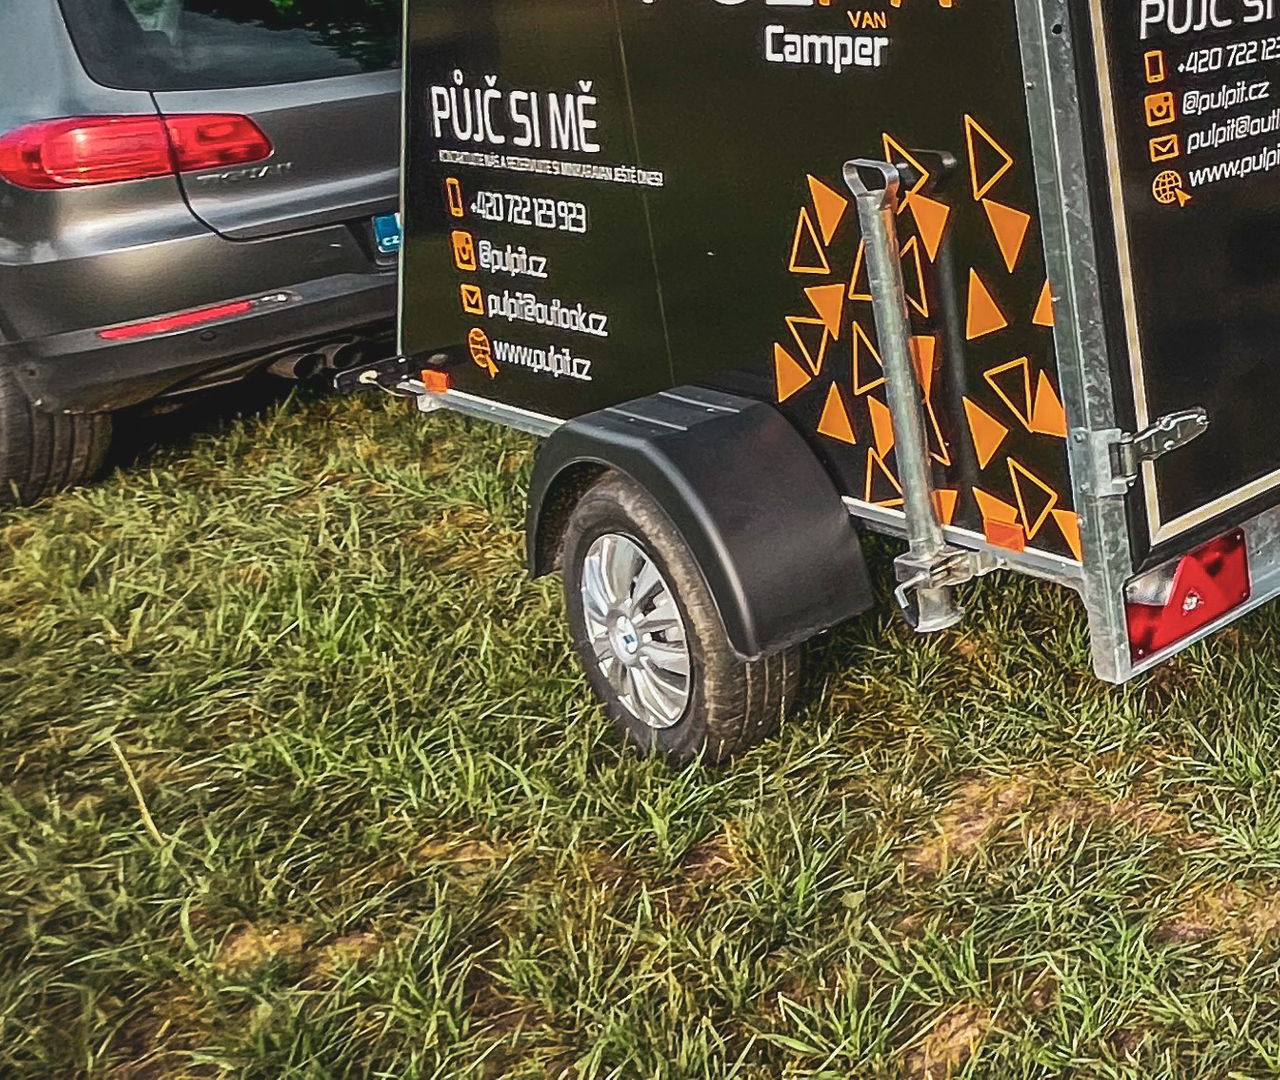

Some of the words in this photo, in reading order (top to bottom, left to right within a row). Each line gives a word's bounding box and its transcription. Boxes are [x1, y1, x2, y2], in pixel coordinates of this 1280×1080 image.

[847, 10, 887, 29] VAN
[765, 24, 889, 74] Camper
[1177, 47, 1223, 74] +420
[1225, 40, 1257, 68] 722
[430, 69, 505, 145] PŮJČ
[509, 90, 542, 148] SI
[549, 80, 601, 153] MĚ
[1182, 81, 1271, 116] @pulpit.cz
[470, 191, 504, 222] +420
[504, 194, 533, 225] 722
[557, 200, 586, 233] 923
[382, 235, 400, 247] CZ
[478, 239, 548, 278] @pulpit.cz
[487, 289, 609, 337] pulpit@outlook.cz
[492, 340, 593, 381] www.pulpit.cz
